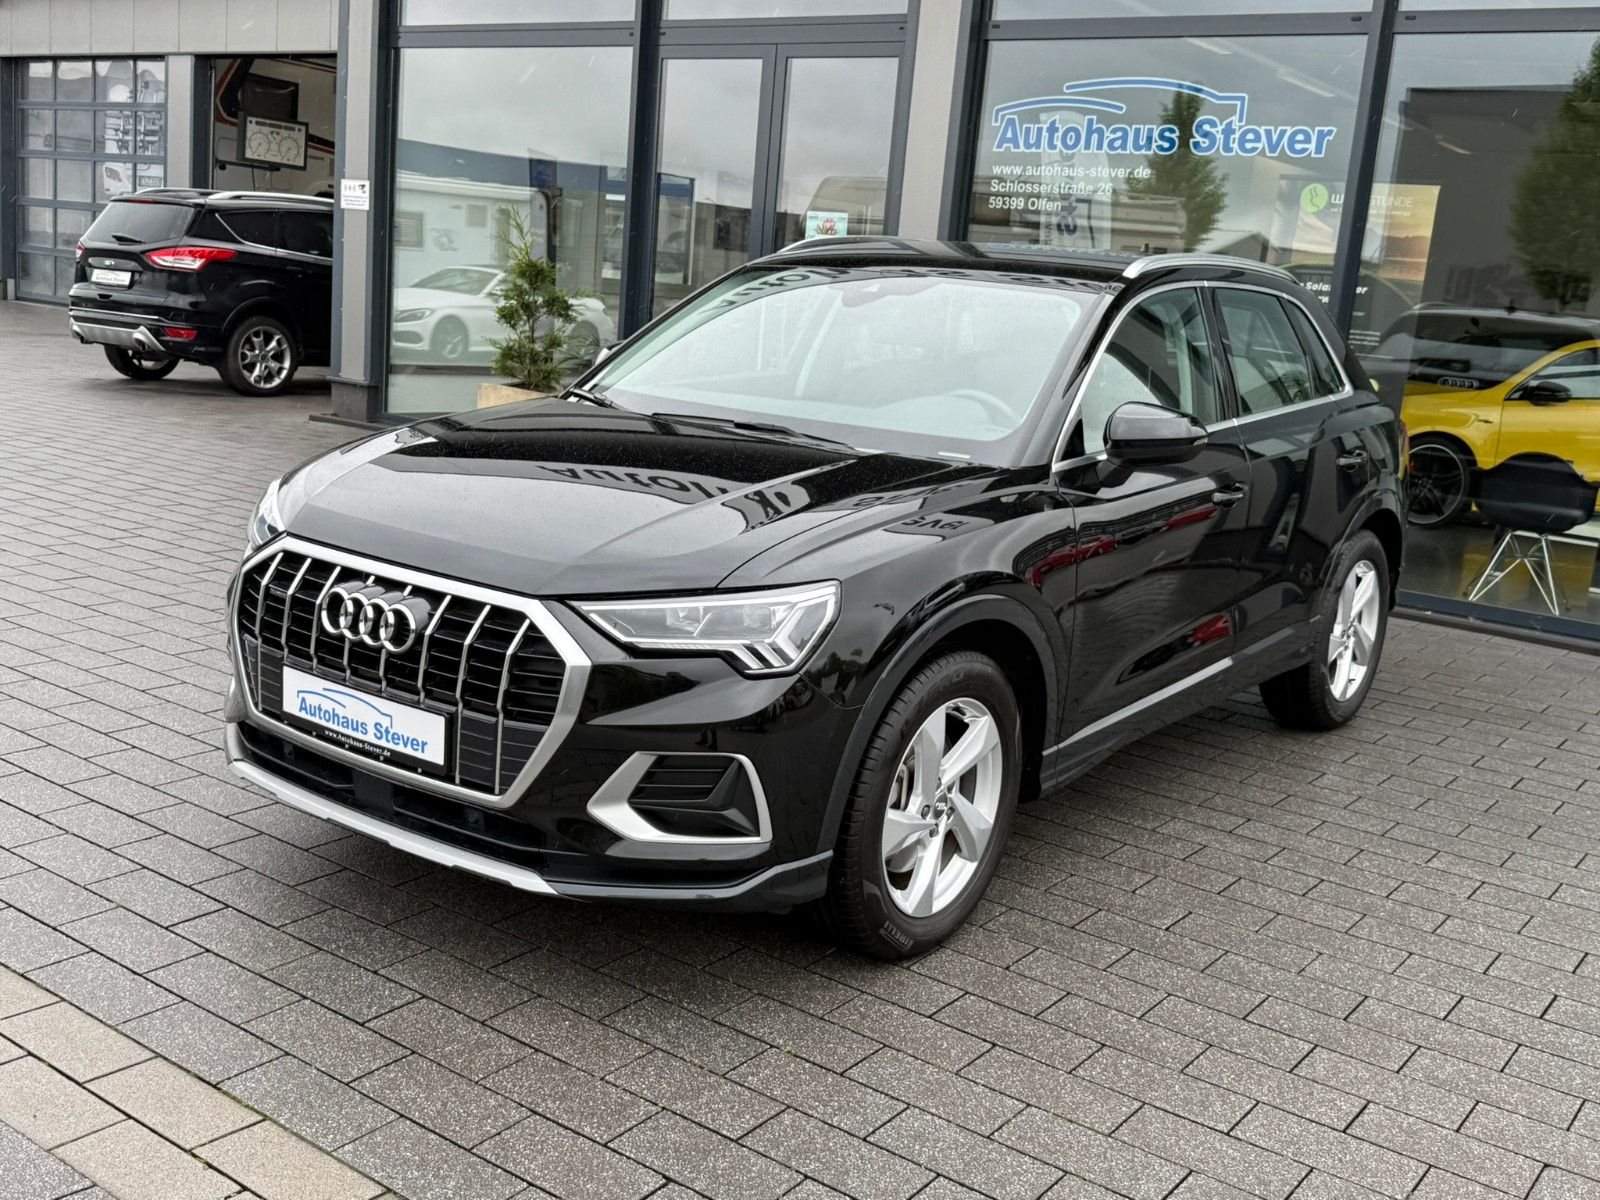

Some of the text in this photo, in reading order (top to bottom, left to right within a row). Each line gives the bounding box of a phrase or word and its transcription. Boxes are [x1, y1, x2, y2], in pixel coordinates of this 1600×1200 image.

[992, 114, 1338, 158] Autohaus Stever
[991, 164, 1152, 179] www.autohaus-stever.de
[989, 178, 1114, 196] Schlosserstraße 26
[987, 196, 1025, 210] 59399
[298, 696, 428, 754] Autohaus Stever
